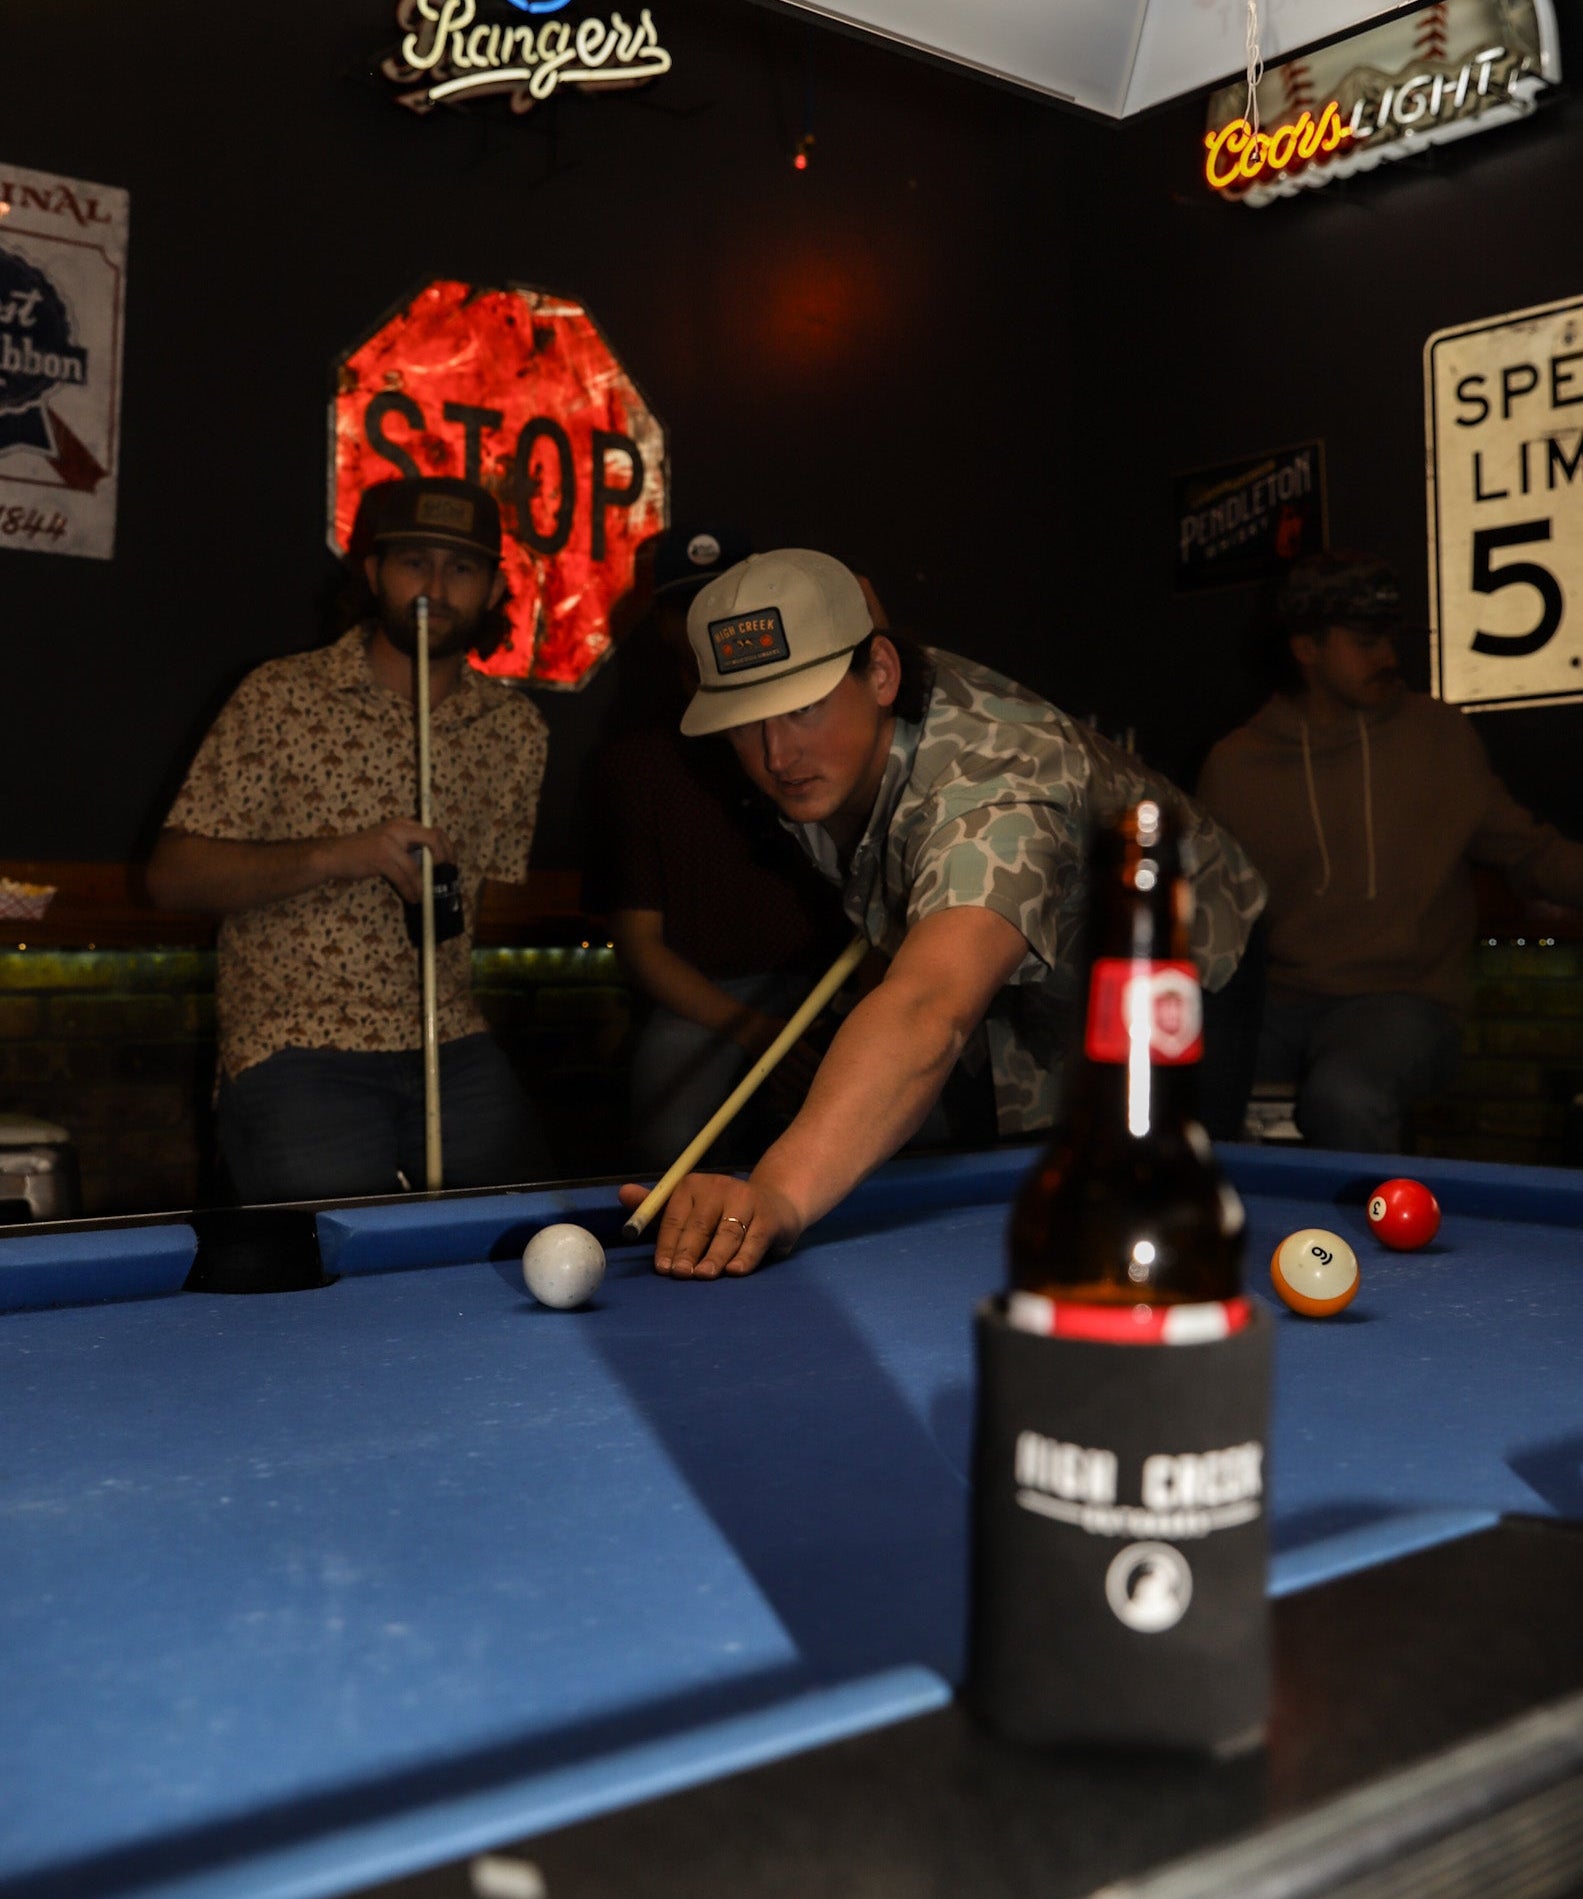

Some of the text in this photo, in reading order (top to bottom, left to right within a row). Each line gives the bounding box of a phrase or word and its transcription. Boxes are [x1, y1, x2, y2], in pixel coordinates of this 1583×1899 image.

[402, 0, 672, 100] Rangers
[1204, 46, 1506, 189] Coors LIGHT
[365, 392, 644, 560] STOP
[1180, 450, 1313, 564] PENDLETON
[738, 619, 775, 634] CREEK
[1472, 519, 1562, 657] 5
[1373, 1201, 1381, 1215] 3
